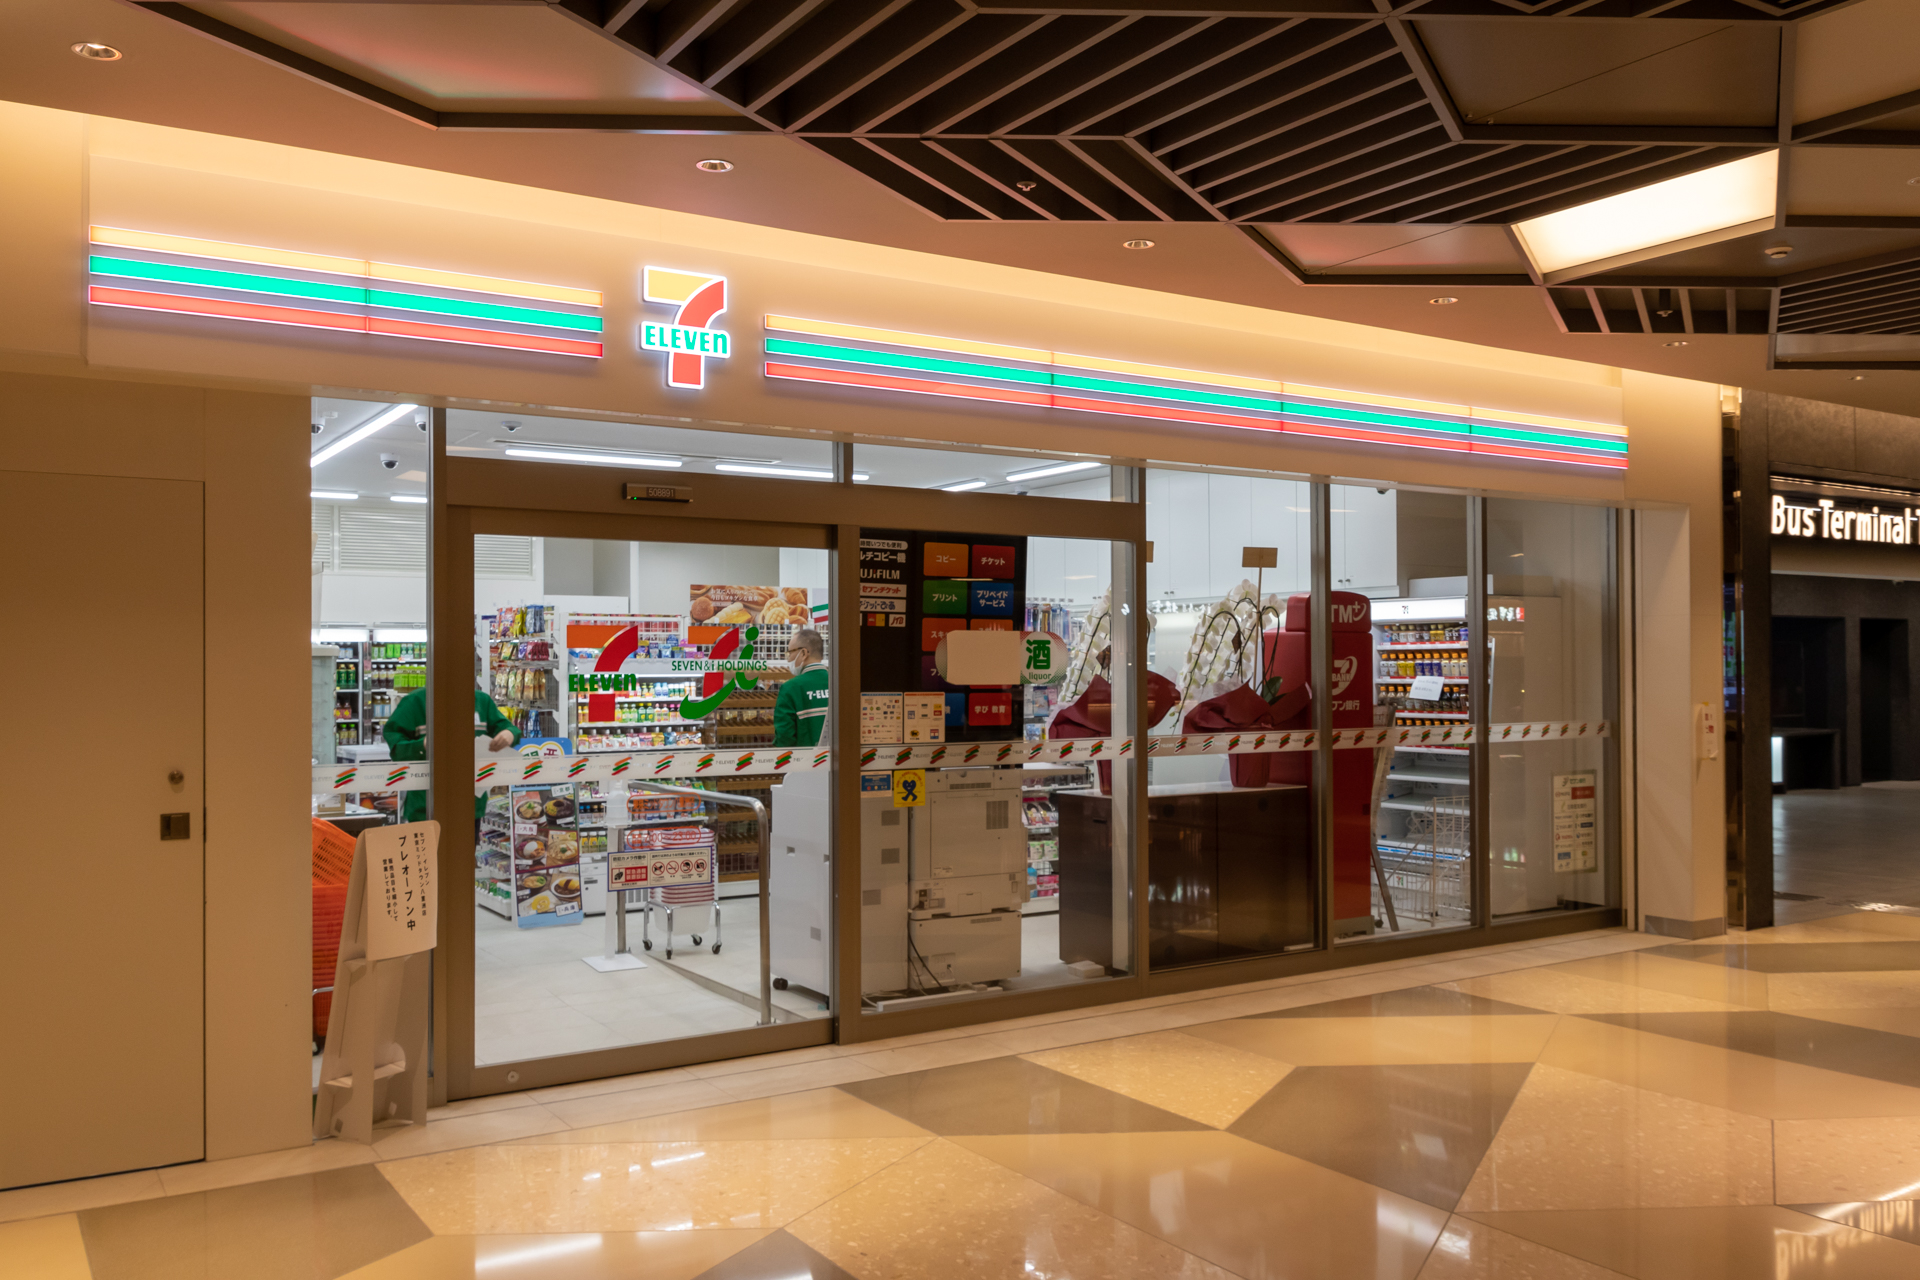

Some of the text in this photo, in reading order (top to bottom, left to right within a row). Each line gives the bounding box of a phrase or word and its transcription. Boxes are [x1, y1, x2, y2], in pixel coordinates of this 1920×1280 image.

[648, 487, 674, 498] 508891
[1770, 494, 1816, 537] Bus
[1818, 498, 1912, 545] Terminal
[935, 555, 957, 563] コピー
[980, 557, 1006, 566] チケット
[862, 585, 901, 594] セブンチケット
[932, 593, 958, 602] プリント
[976, 590, 1009, 599] プリペイド
[978, 599, 1006, 608] サービス
[890, 616, 904, 625] JTB
[1025, 638, 1051, 670] 酒
[717, 660, 768, 671] HOLDINGS
[1028, 672, 1052, 681] liquor
[974, 705, 1006, 714] 学び 教育
[398, 834, 416, 932] プレオープン中
